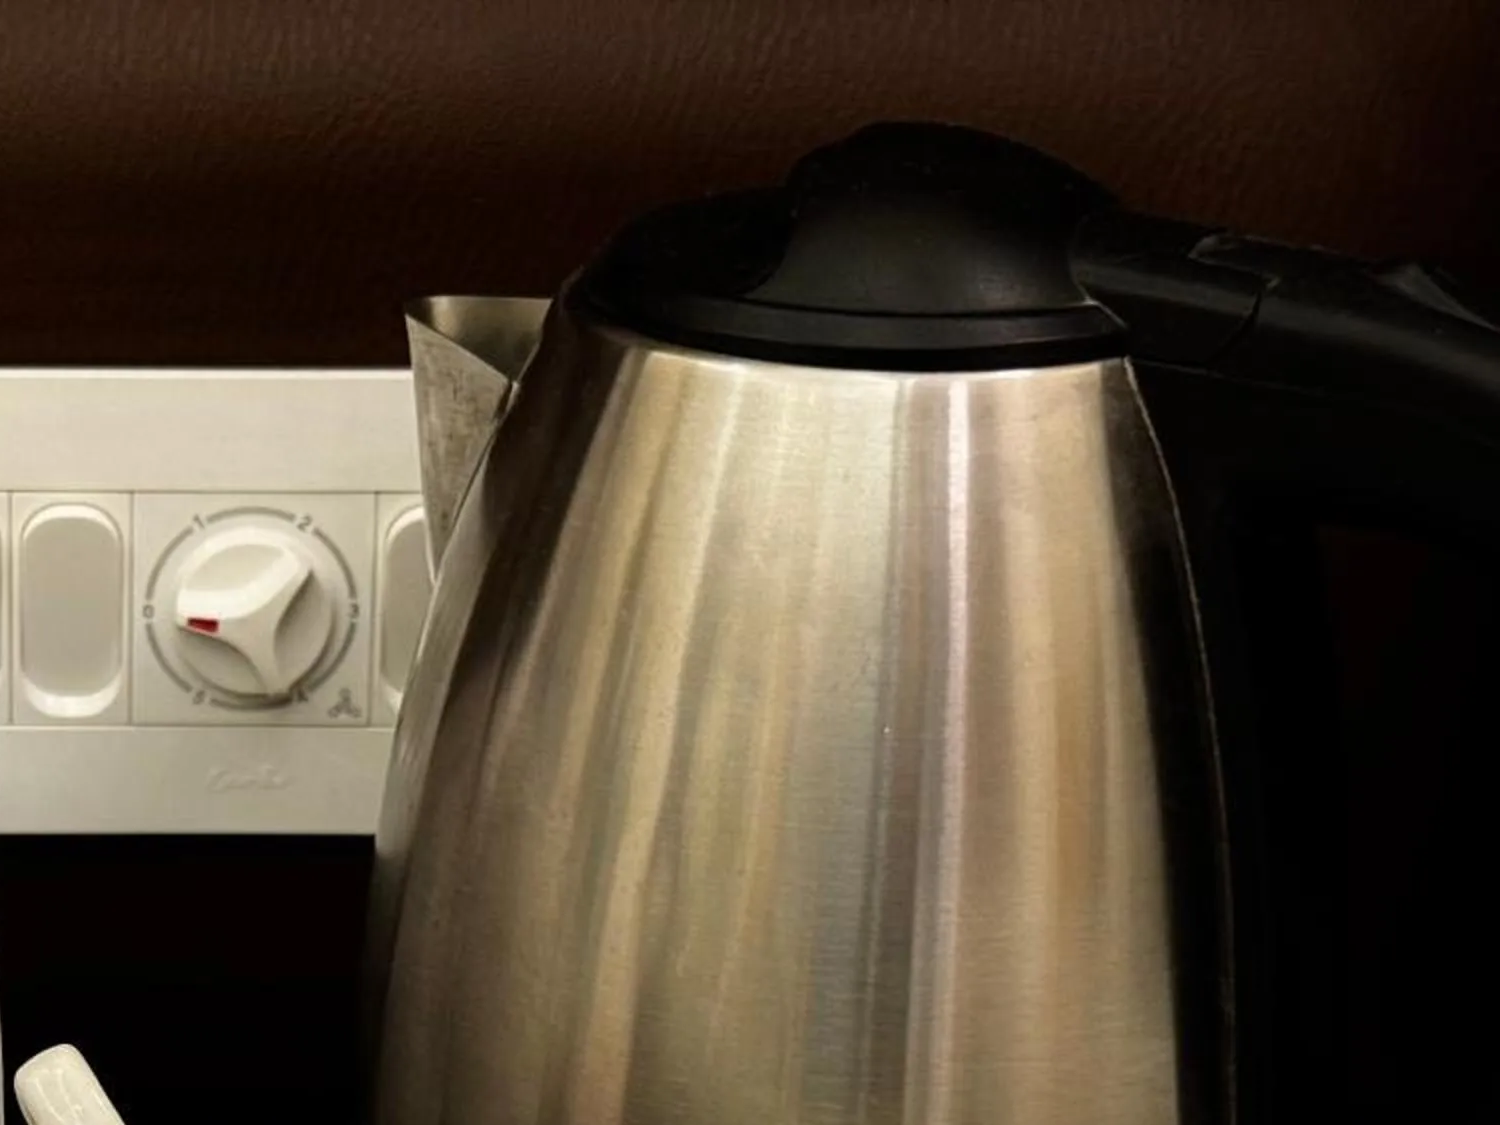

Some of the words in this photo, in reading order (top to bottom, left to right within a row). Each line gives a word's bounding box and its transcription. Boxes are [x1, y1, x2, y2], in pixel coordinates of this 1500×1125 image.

[192, 514, 206, 529] 1
[296, 515, 313, 531] 2
[348, 603, 360, 619] 3
